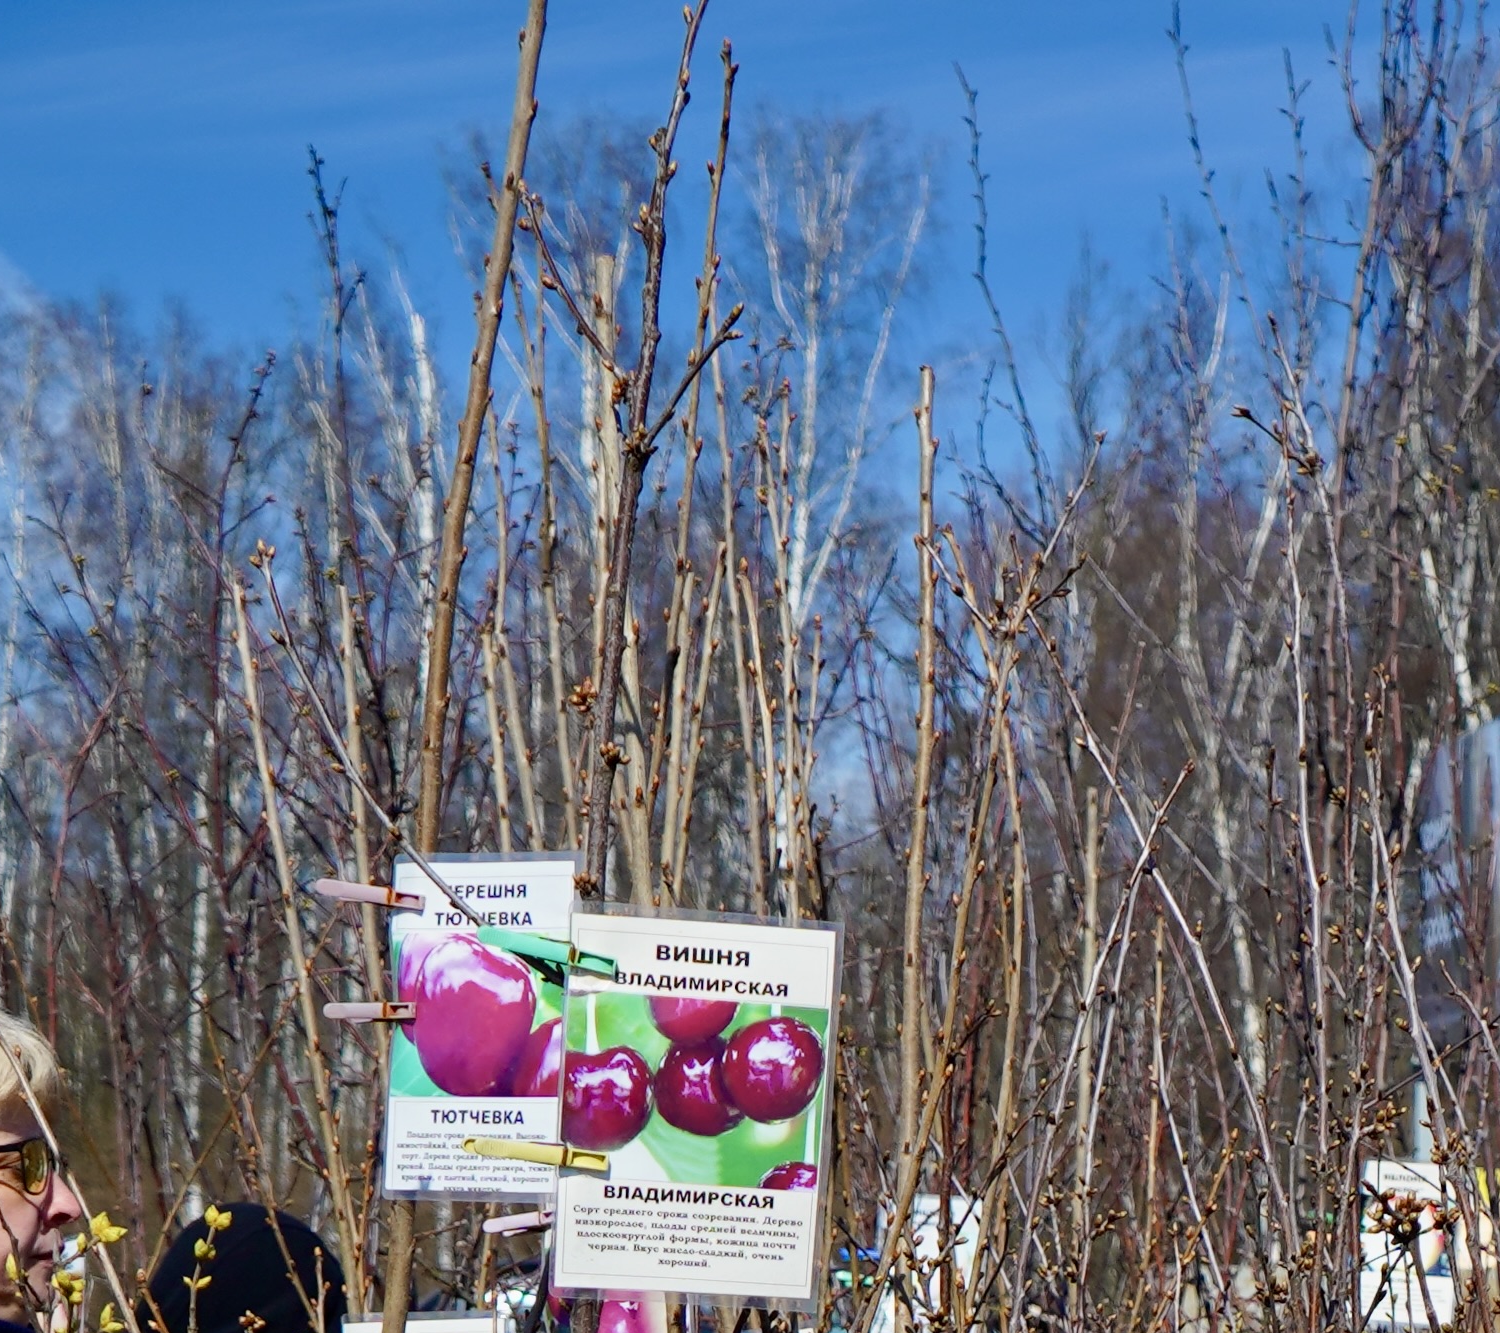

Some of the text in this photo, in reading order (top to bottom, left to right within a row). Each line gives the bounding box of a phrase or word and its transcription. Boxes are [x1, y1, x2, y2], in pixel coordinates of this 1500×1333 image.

[448, 884, 527, 899] ЕРЕШНЯ
[656, 944, 751, 968] ВИШНЯ
[615, 971, 789, 998] ВЛАДИМИРСКАЯ
[431, 1109, 524, 1125] ТЮТЧЕВКА
[604, 1185, 775, 1210] ВЛАДИМИРСКАЯ
[573, 1205, 804, 1228] Сорт среднего срока созревания. Дерево
[575, 1218, 800, 1240] низкорослое, плоды средней величины,
[577, 1230, 797, 1250] плоскоокруглой формы, кожица почти
[588, 1243, 785, 1261] черная. Вкус кисло-сладкий, очень
[658, 1258, 712, 1268] хороший.
